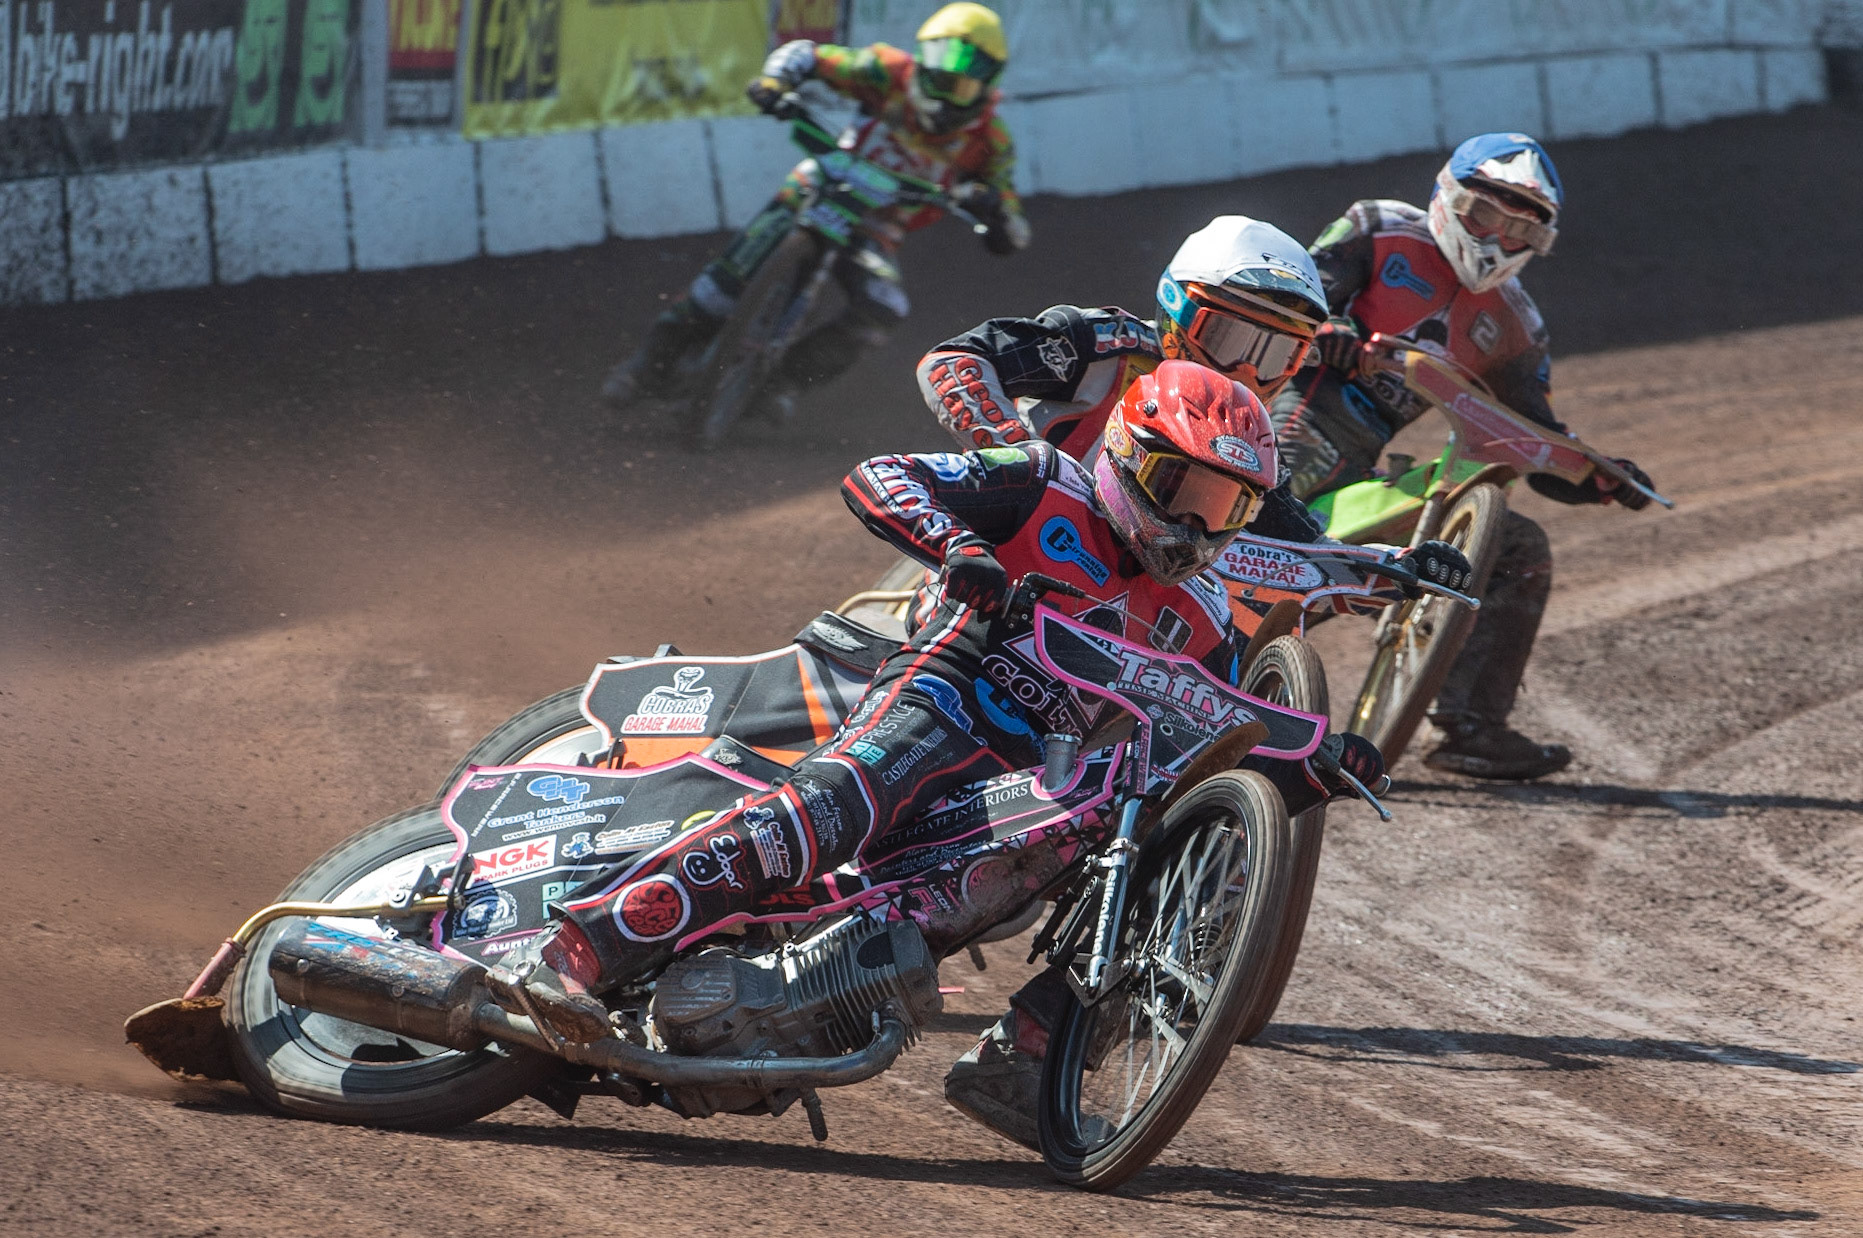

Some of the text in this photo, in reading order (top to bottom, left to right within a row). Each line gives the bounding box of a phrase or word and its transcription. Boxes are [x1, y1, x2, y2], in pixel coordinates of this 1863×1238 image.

[927, 363, 995, 449] Haye
[1224, 552, 1306, 577] GARAGE
[1229, 563, 1300, 586] MAHAL
[981, 654, 1085, 739] COLT
[1119, 651, 1259, 726] Taffys
[640, 695, 711, 715] COBRAS
[624, 716, 706, 731] GARAGE MAHAL
[488, 796, 624, 828] Grant Henderson
[524, 812, 585, 829] Tankers
[872, 815, 950, 848] ASTLEGATE
[955, 784, 1028, 821] INTERIORS
[474, 840, 549, 875] NGK
[512, 860, 549, 874] PLUGS
[698, 835, 743, 889] Edgar
